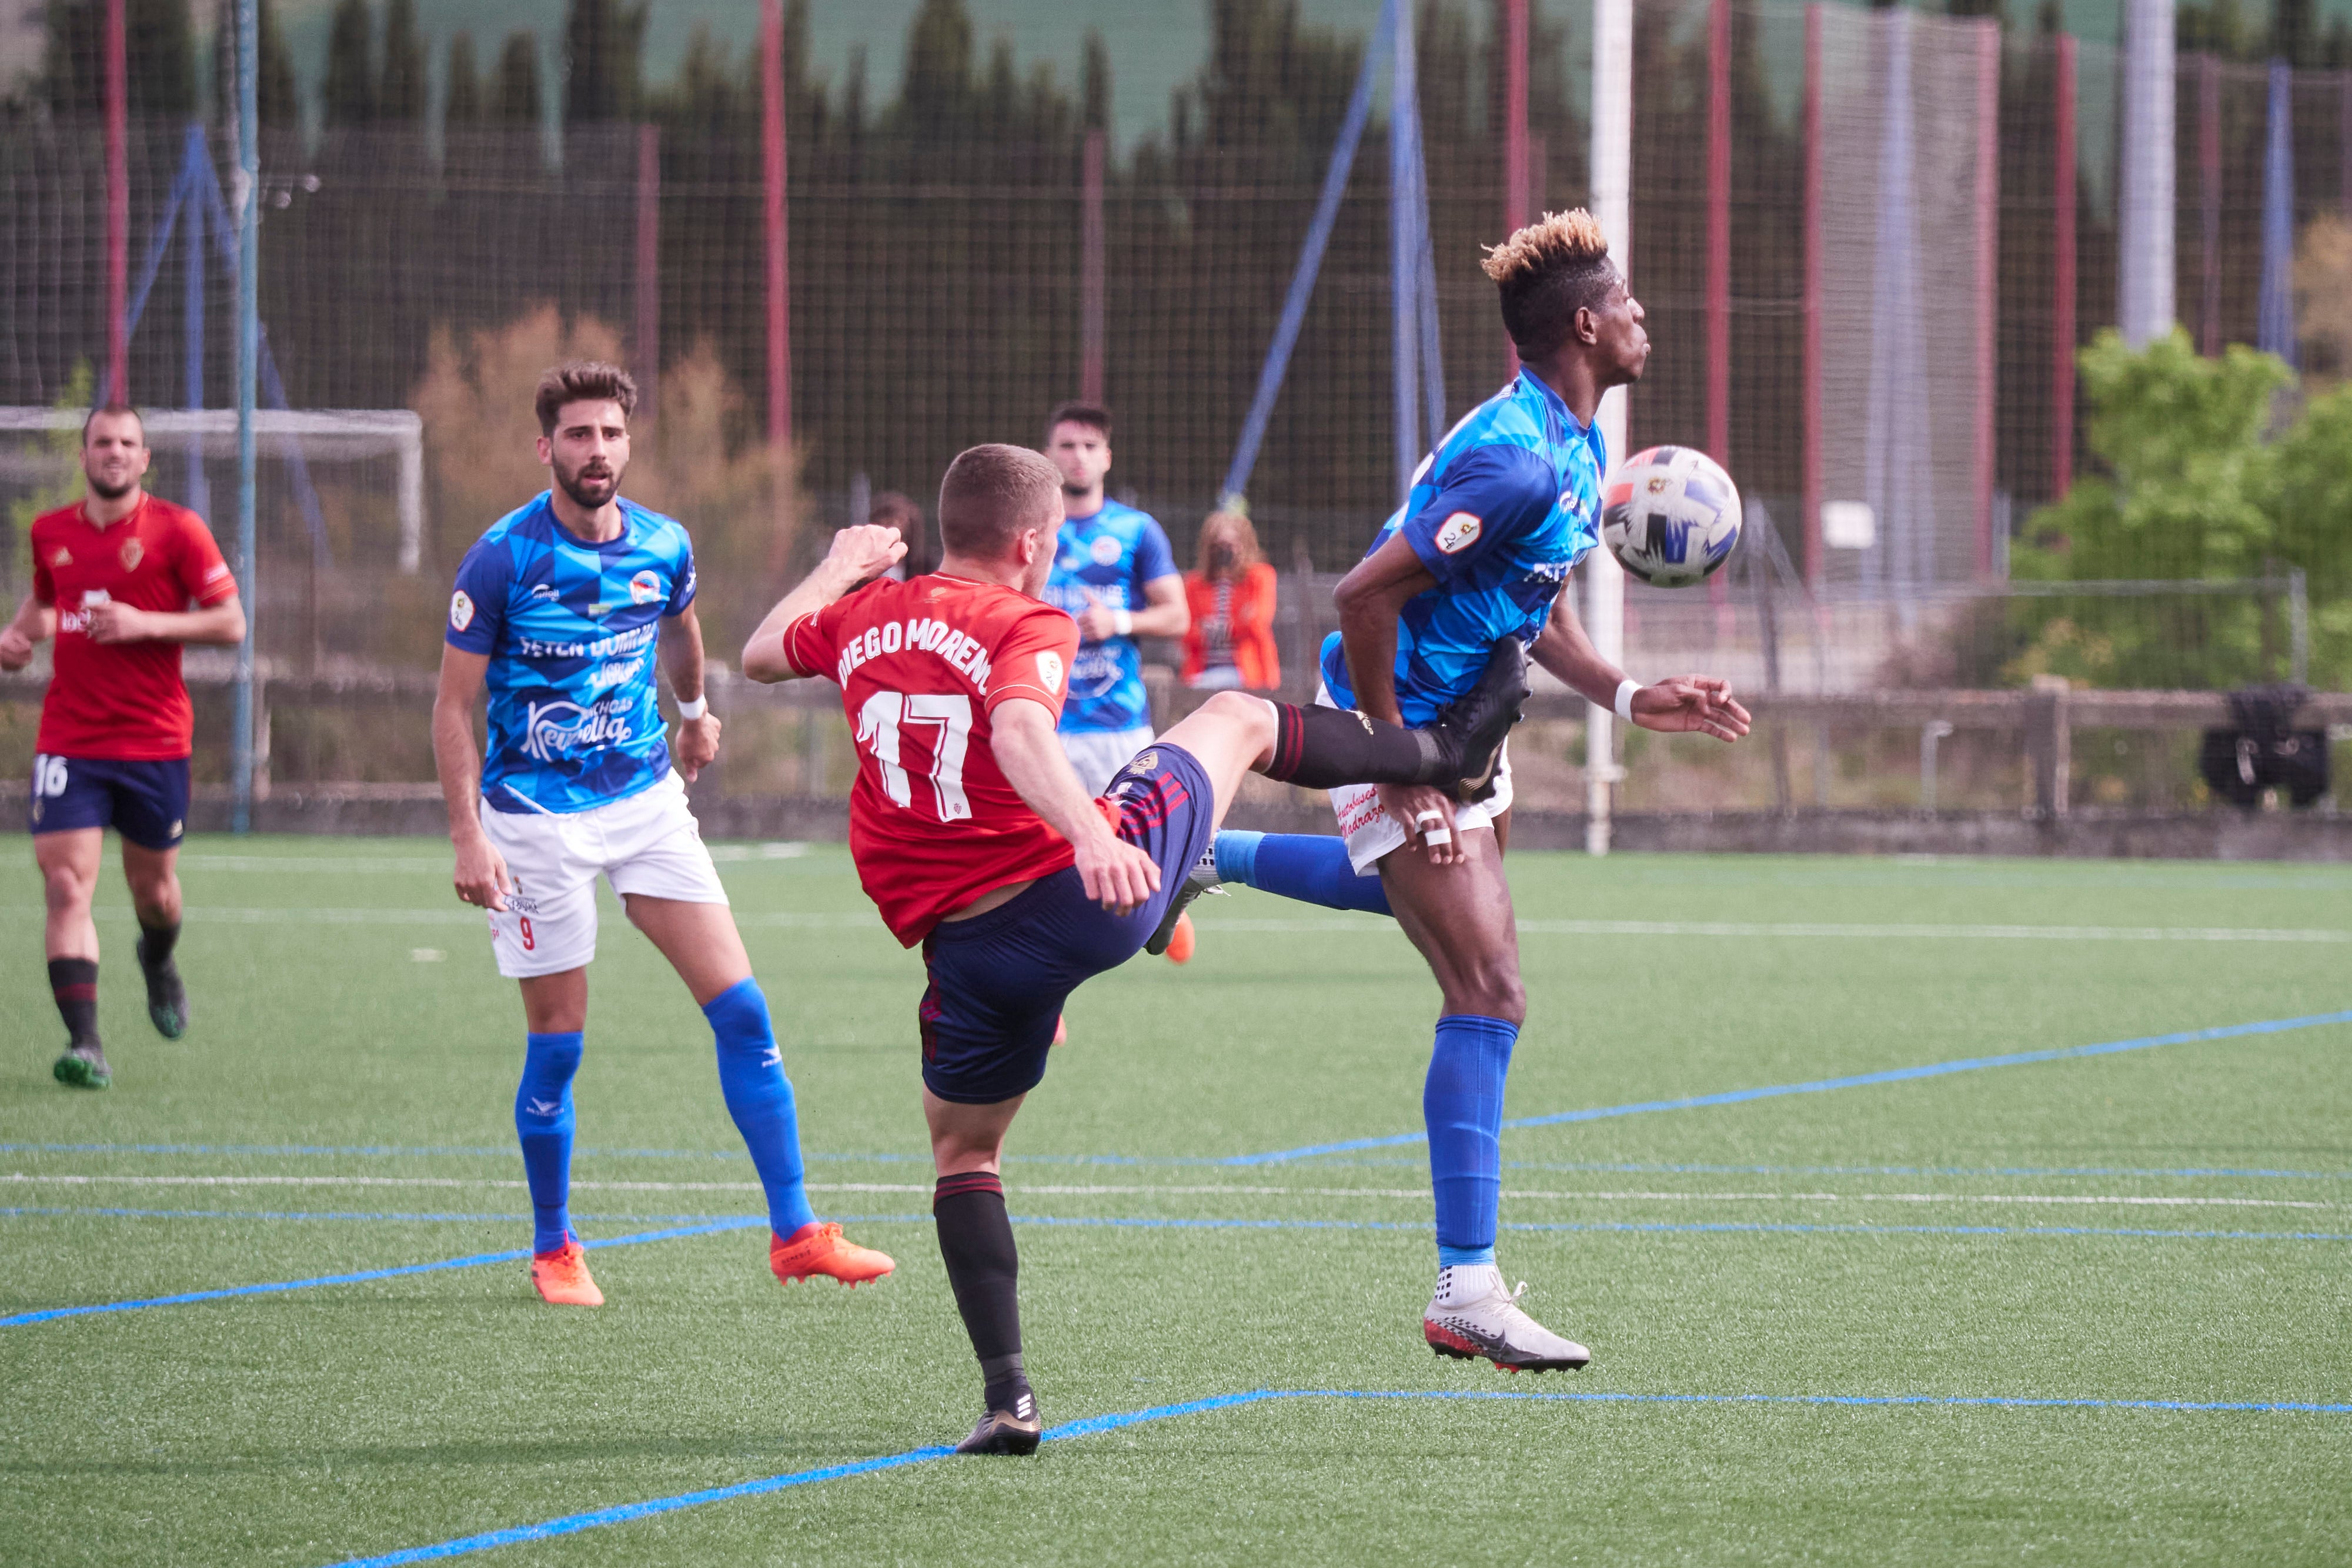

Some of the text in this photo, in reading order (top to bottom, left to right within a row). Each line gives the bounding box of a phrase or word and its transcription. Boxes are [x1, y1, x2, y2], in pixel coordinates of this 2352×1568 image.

[838, 621, 902, 691] DIEGO
[36, 754, 68, 797] 16
[856, 691, 973, 823] 17
[520, 915, 535, 951] 9
